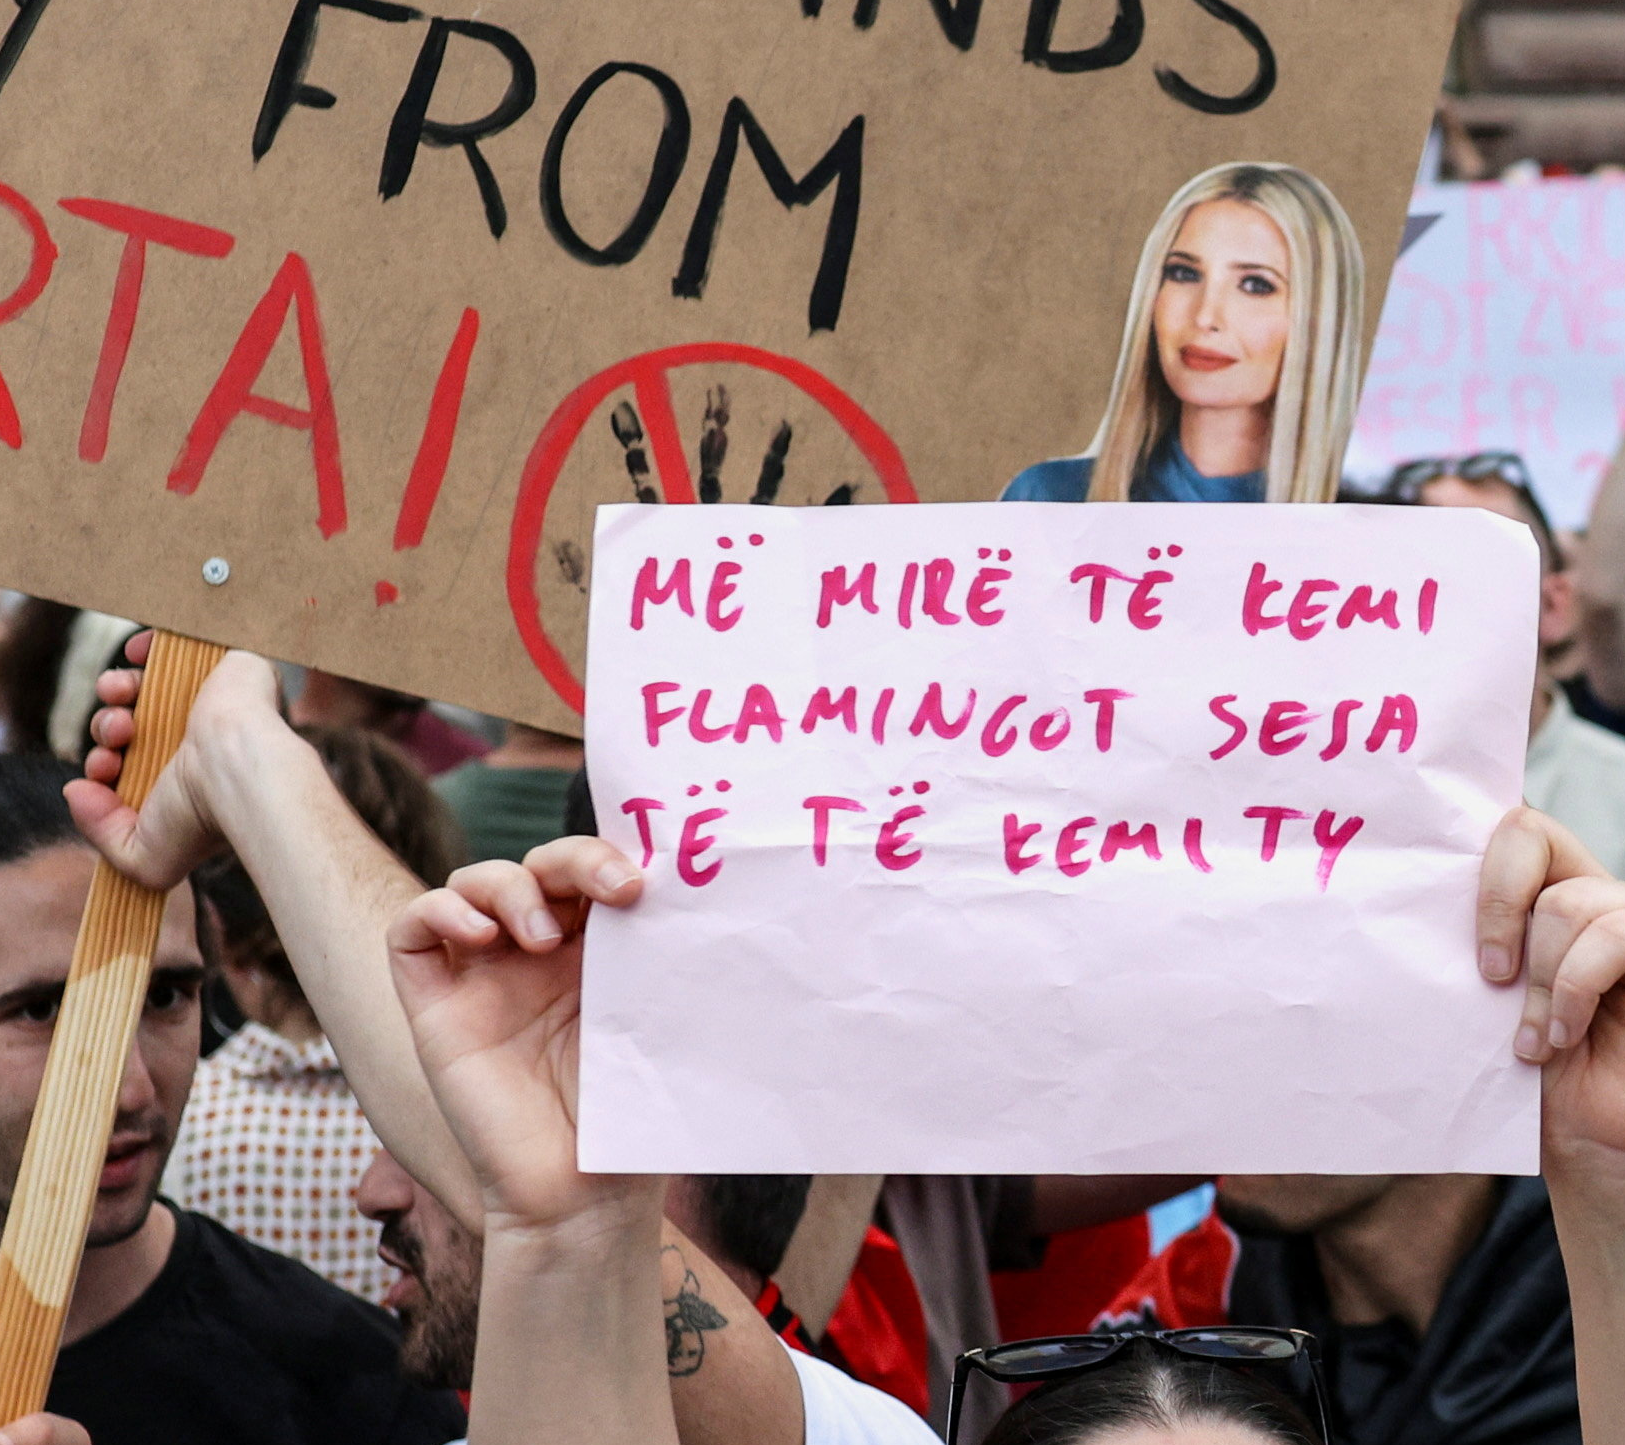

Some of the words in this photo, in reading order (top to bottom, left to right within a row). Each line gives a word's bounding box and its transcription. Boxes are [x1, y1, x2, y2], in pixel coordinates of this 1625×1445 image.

[630, 534, 764, 632] MË
[816, 547, 1012, 629] MIRË
[1069, 543, 1183, 632] TË
[1241, 561, 1439, 642] KEMI
[621, 779, 732, 888] TË
[801, 780, 931, 872] TË
